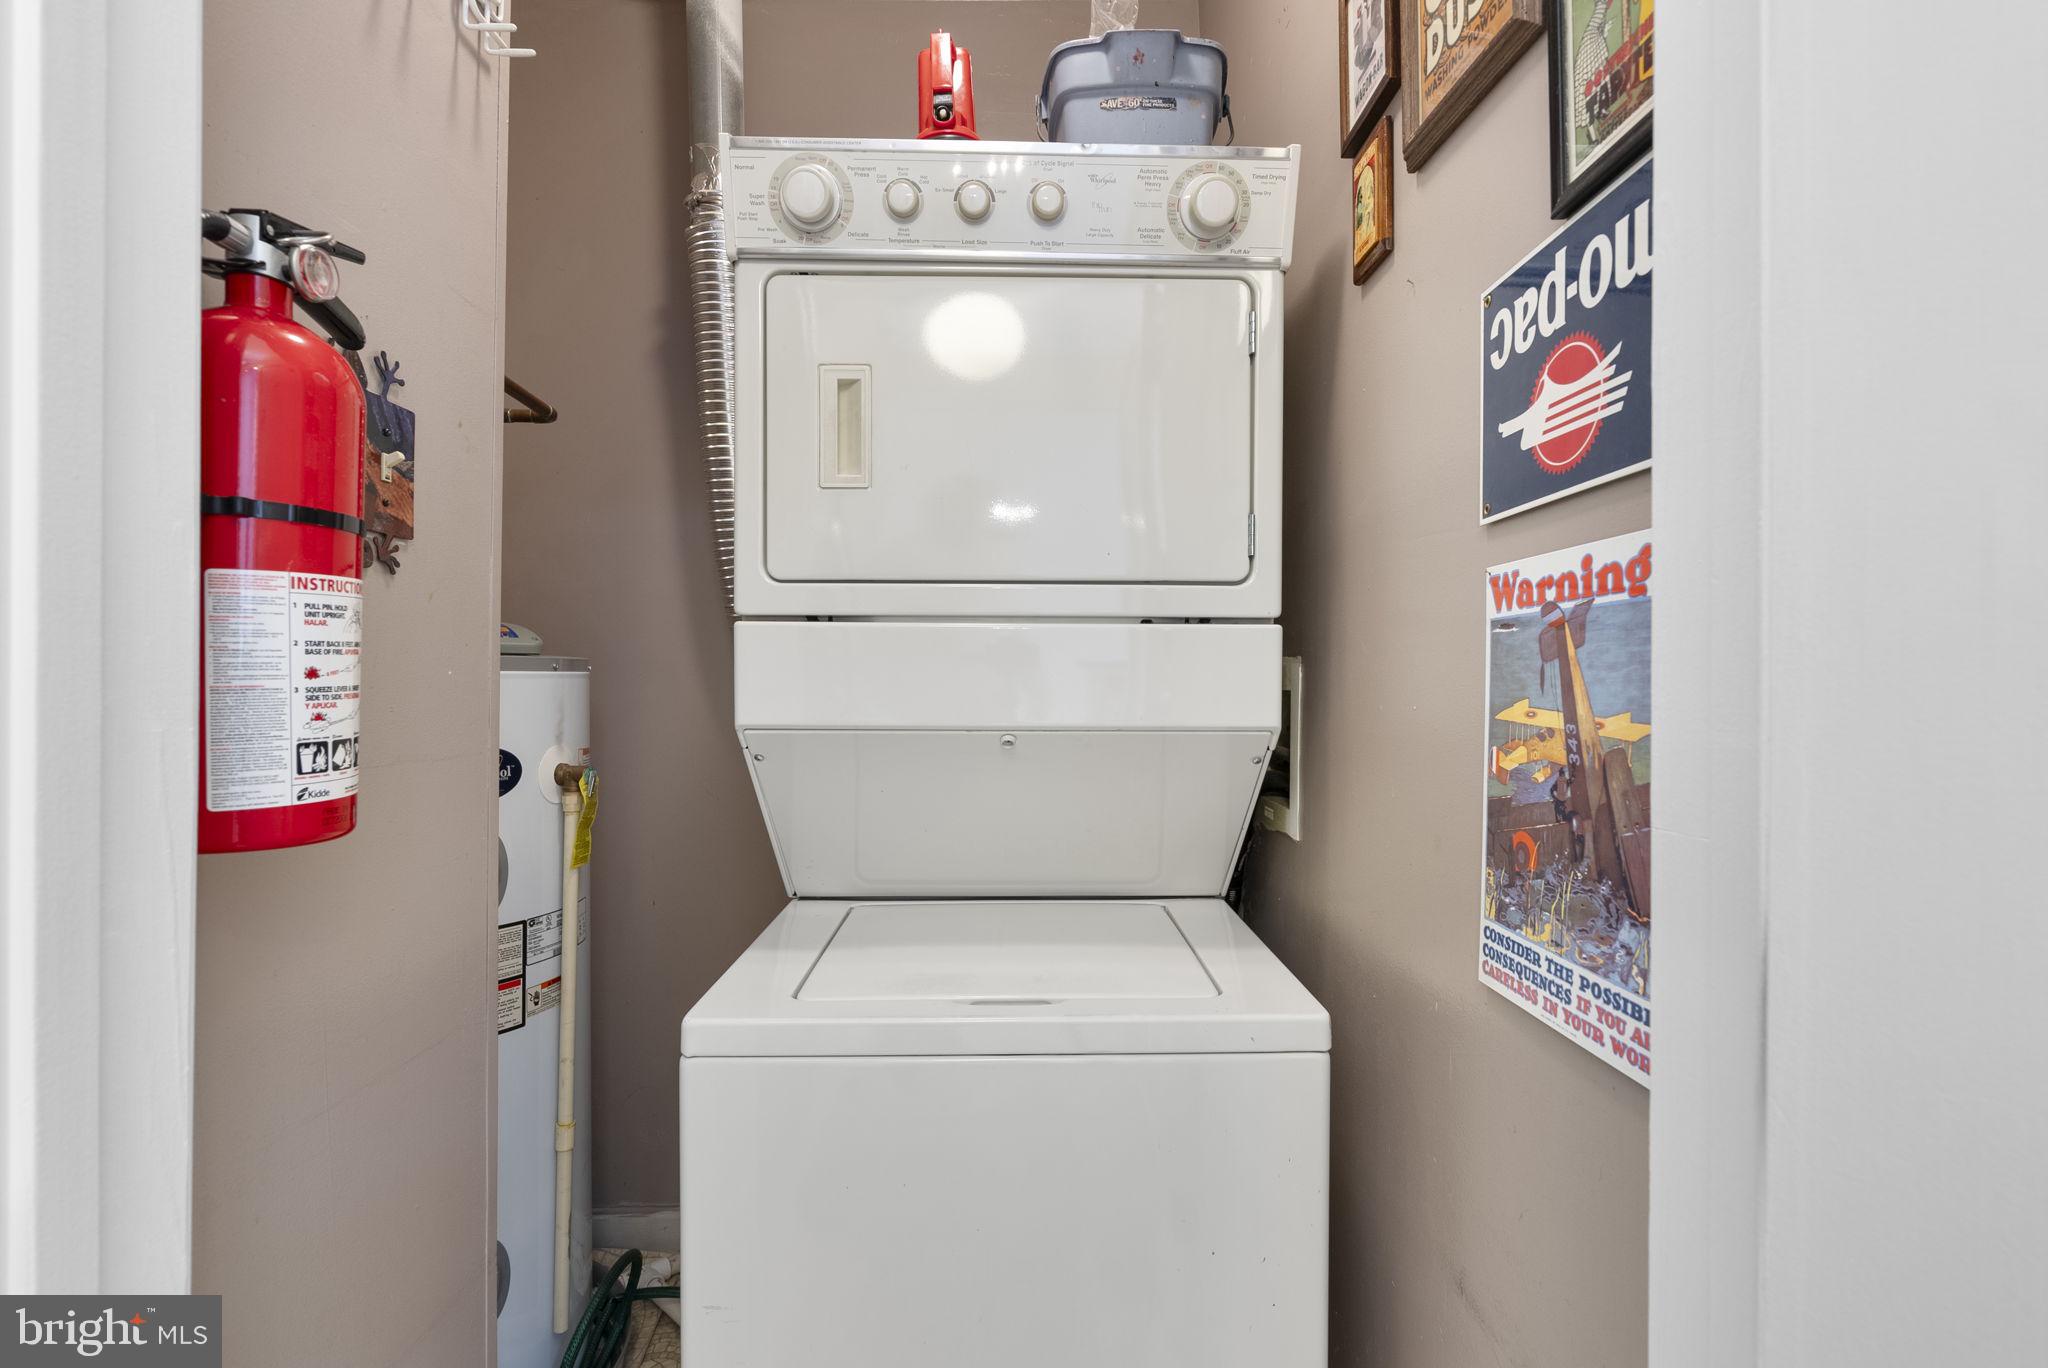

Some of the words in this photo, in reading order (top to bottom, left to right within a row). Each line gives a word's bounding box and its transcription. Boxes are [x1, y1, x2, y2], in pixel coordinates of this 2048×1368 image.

[1041, 160, 1056, 168] Cycle
[1089, 177, 1117, 185] Whirlpool
[1268, 174, 1286, 182] Drying
[888, 237, 920, 245] Temperature
[1489, 542, 1652, 614] Warning
[304, 602, 321, 610] PULL
[334, 604, 348, 612] HOLD
[304, 611, 320, 619] UNIT
[304, 640, 326, 648] START
[327, 640, 341, 648] BACK
[304, 648, 322, 656] BASE
[323, 648, 331, 656] OF
[305, 686, 333, 695] SQUEEZE
[334, 685, 347, 693] LEVER
[305, 693, 321, 702] SIDE
[322, 693, 330, 701] TO
[1565, 723, 1580, 766] 343
[308, 787, 331, 799] Kidde
[1483, 925, 1542, 969] CONSIDER
[1545, 956, 1574, 988] THE
[1482, 943, 1572, 1006] CONSEQUENCES
[1576, 994, 1592, 1017] IF
[1595, 1004, 1627, 1036] YOU
[1481, 959, 1539, 1006] CARELESS
[1542, 995, 1558, 1019] IN
[1562, 1007, 1605, 1047] YOUR
